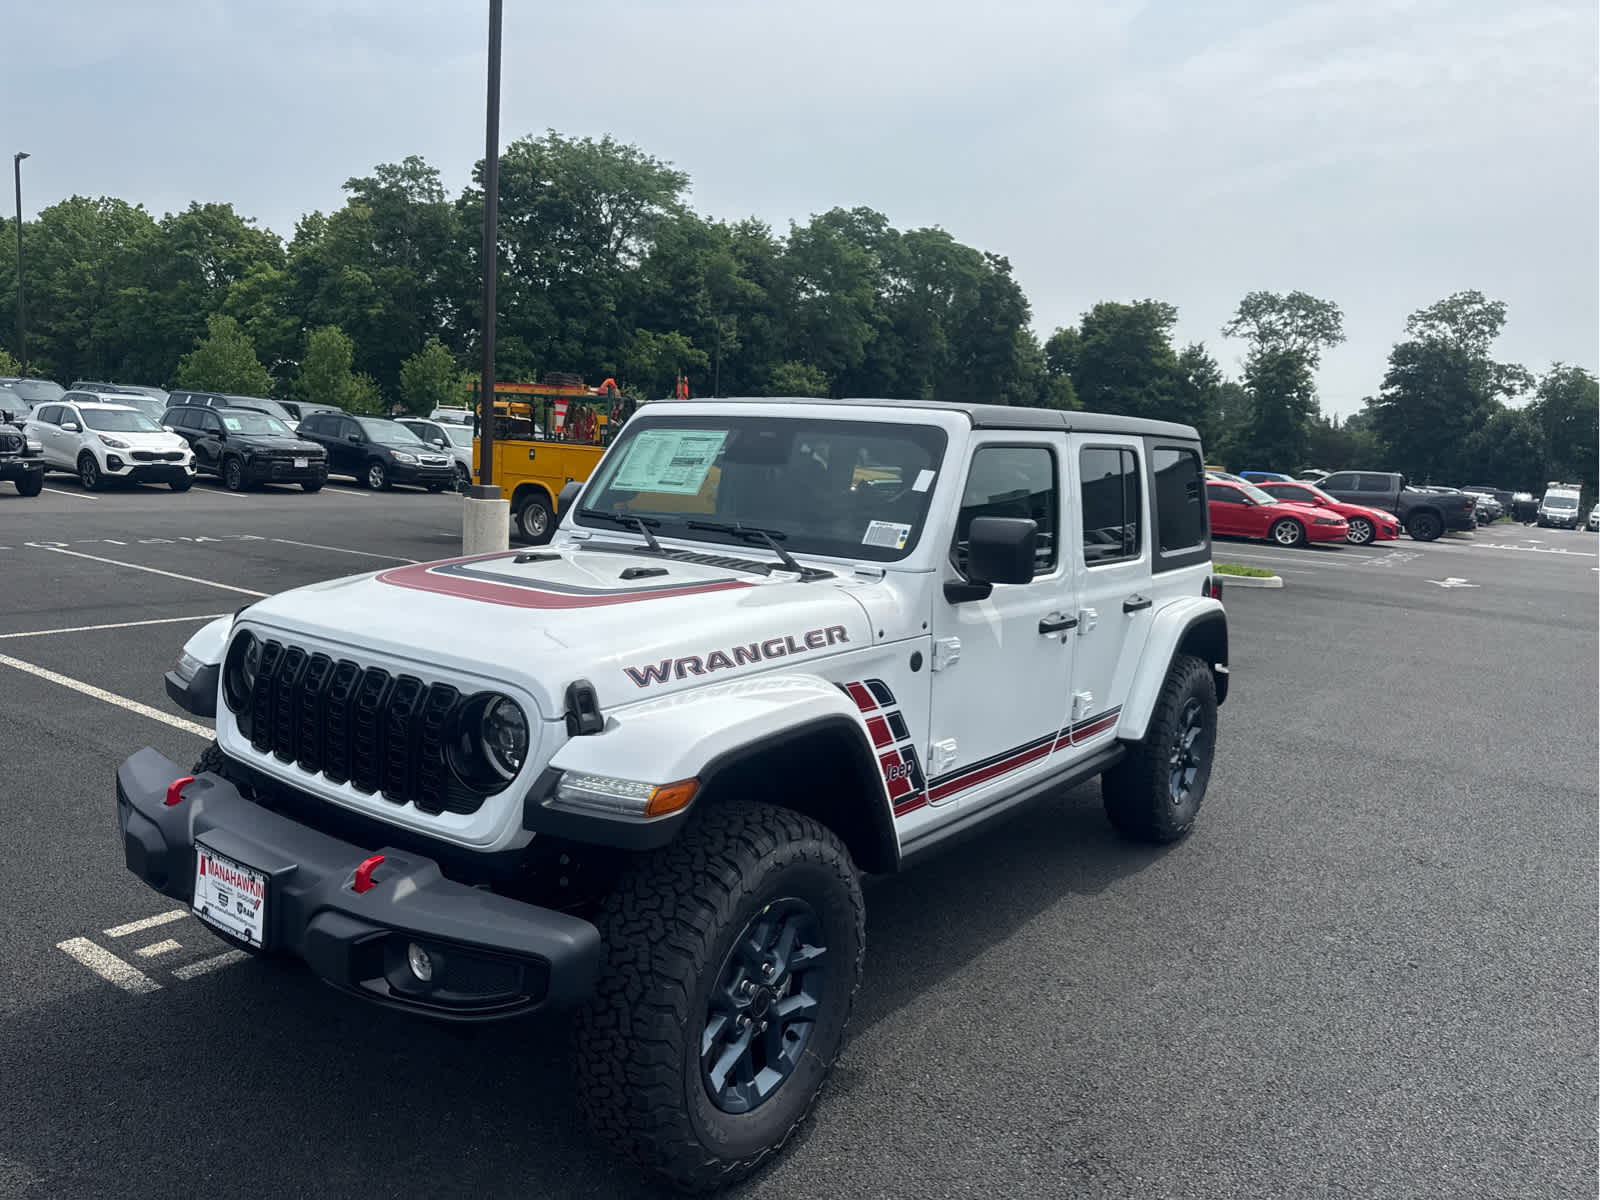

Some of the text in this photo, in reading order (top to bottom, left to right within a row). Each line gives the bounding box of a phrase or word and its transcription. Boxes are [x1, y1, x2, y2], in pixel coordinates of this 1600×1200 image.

[623, 624, 850, 688] WRANGLER
[885, 759, 914, 782] Jeep
[208, 858, 265, 900] MANAHAWKIN
[242, 907, 255, 920] RAM
